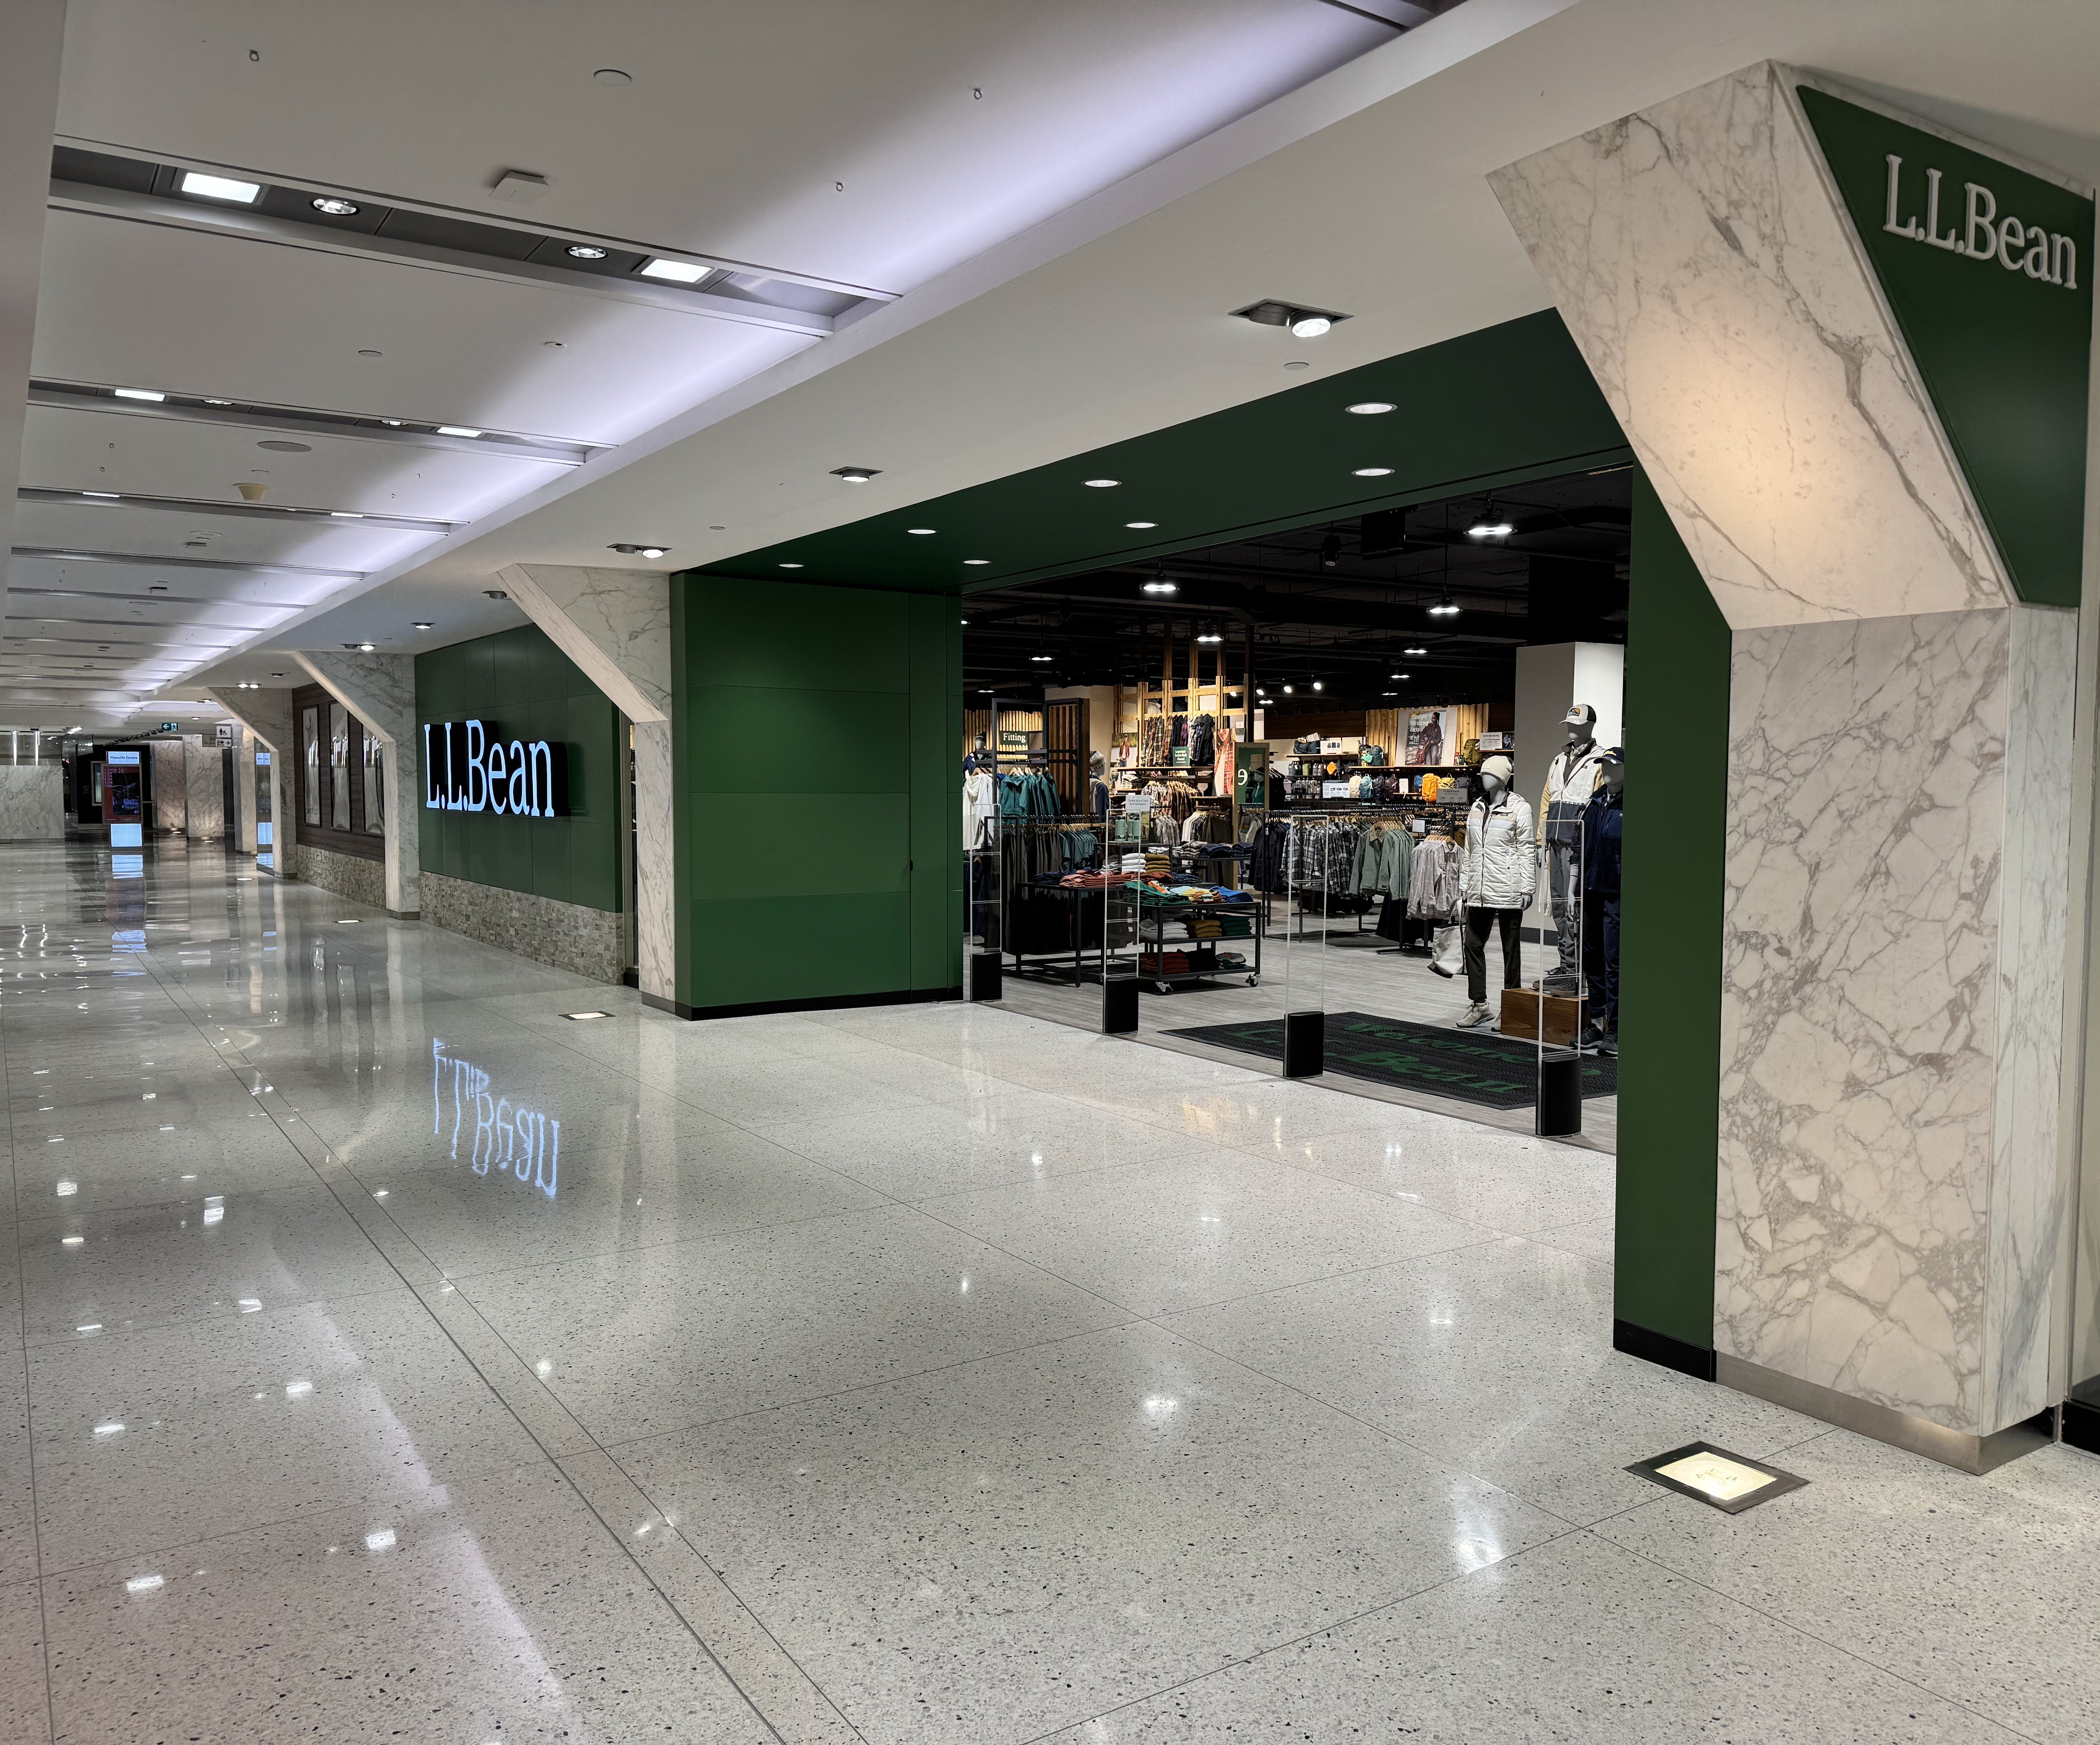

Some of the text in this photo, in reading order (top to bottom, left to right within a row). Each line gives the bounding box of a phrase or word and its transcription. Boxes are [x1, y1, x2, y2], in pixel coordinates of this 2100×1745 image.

[1883, 154, 2077, 289] L.L.Bean
[424, 719, 554, 817] L.L.Bean
[1003, 733, 1026, 743] Fitting
